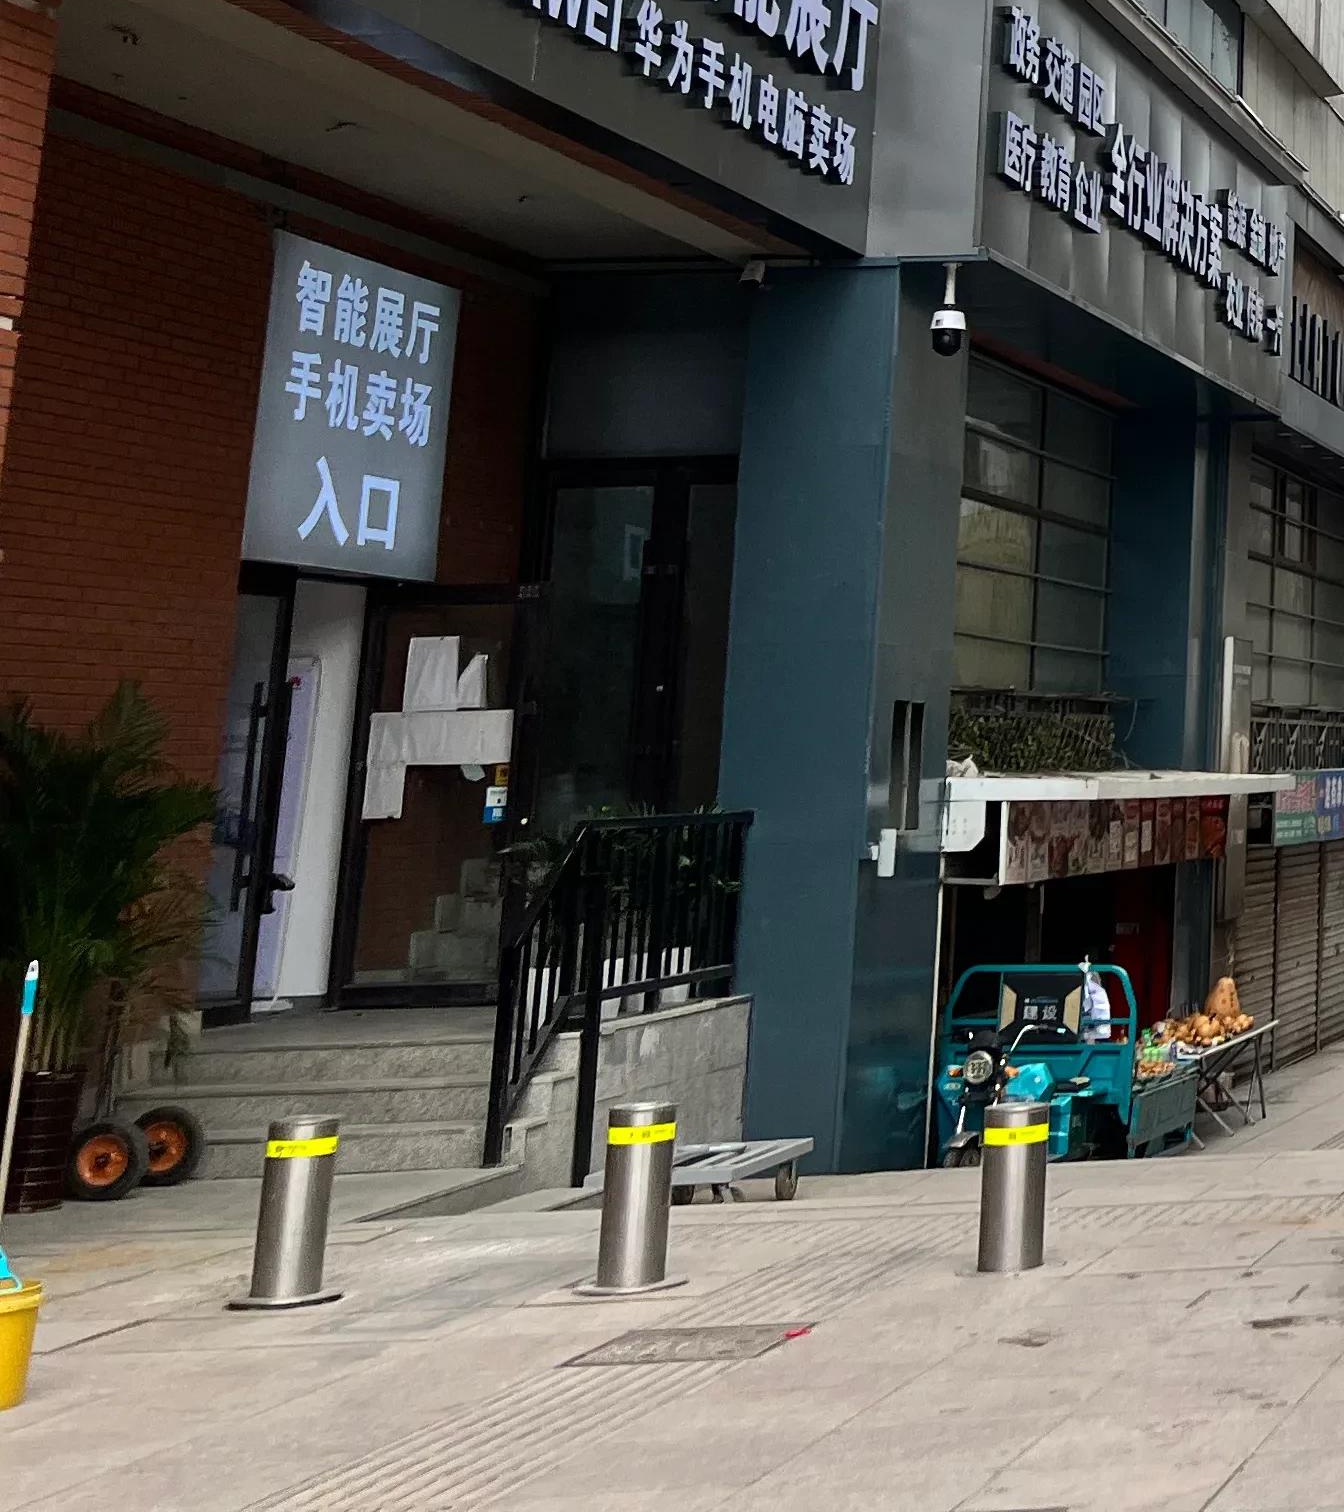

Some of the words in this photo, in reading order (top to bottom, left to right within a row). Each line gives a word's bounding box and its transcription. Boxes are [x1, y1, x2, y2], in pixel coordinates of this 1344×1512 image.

[1044, 37, 1075, 115] 交通
[1077, 62, 1106, 137] 园区
[1040, 132, 1072, 212] 教育
[1074, 161, 1104, 234] 企业
[1109, 123, 1222, 289] 全行业解决方案
[295, 260, 441, 365] 智能展厅
[284, 350, 434, 448] 手机卖场
[297, 455, 401, 551] 入口
